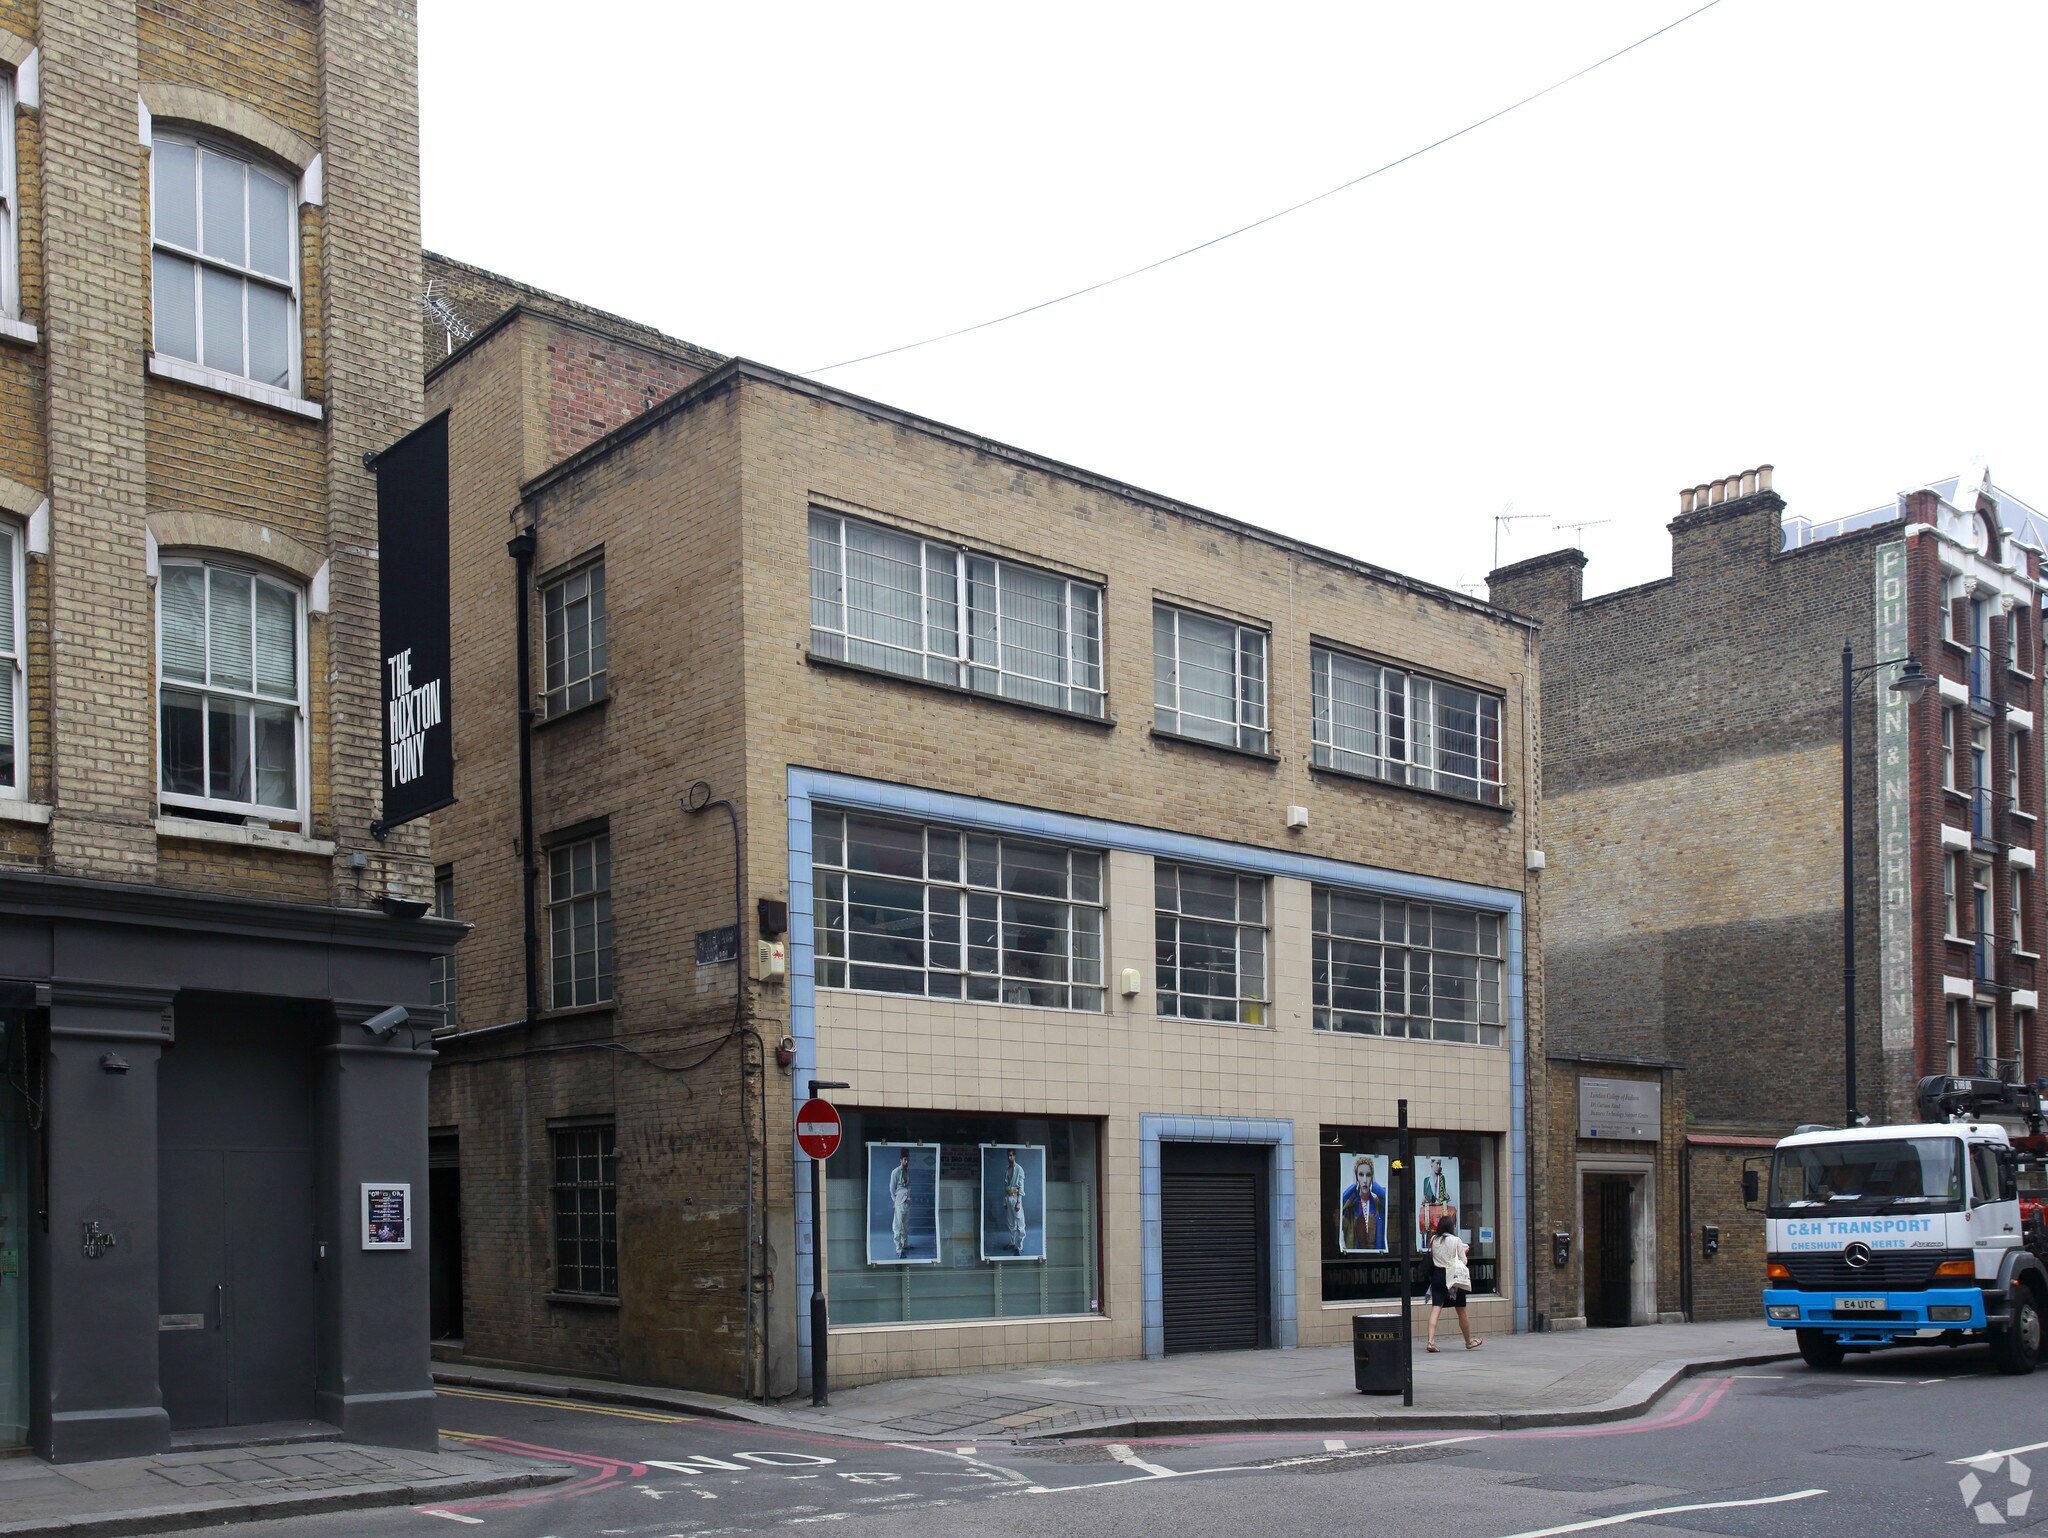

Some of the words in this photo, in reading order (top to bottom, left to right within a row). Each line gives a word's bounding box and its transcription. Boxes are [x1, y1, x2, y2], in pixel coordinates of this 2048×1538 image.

[387, 647, 413, 700] THE
[389, 679, 442, 744] HOXTON
[390, 730, 426, 788] PONY
[1886, 748, 1900, 766] &
[1885, 779, 1907, 1017] NICHOLSON
[1607, 1093, 1620, 1101] College
[1787, 1222, 1822, 1236] C&H
[1828, 1219, 1931, 1235] TRANSPORT
[1791, 1241, 1844, 1251] CHESHUNT
[1872, 1239, 1906, 1250] HERTS
[1844, 1299, 1856, 1310] E4
[1858, 1299, 1876, 1310] UTC
[640, 1450, 838, 1475] NO
